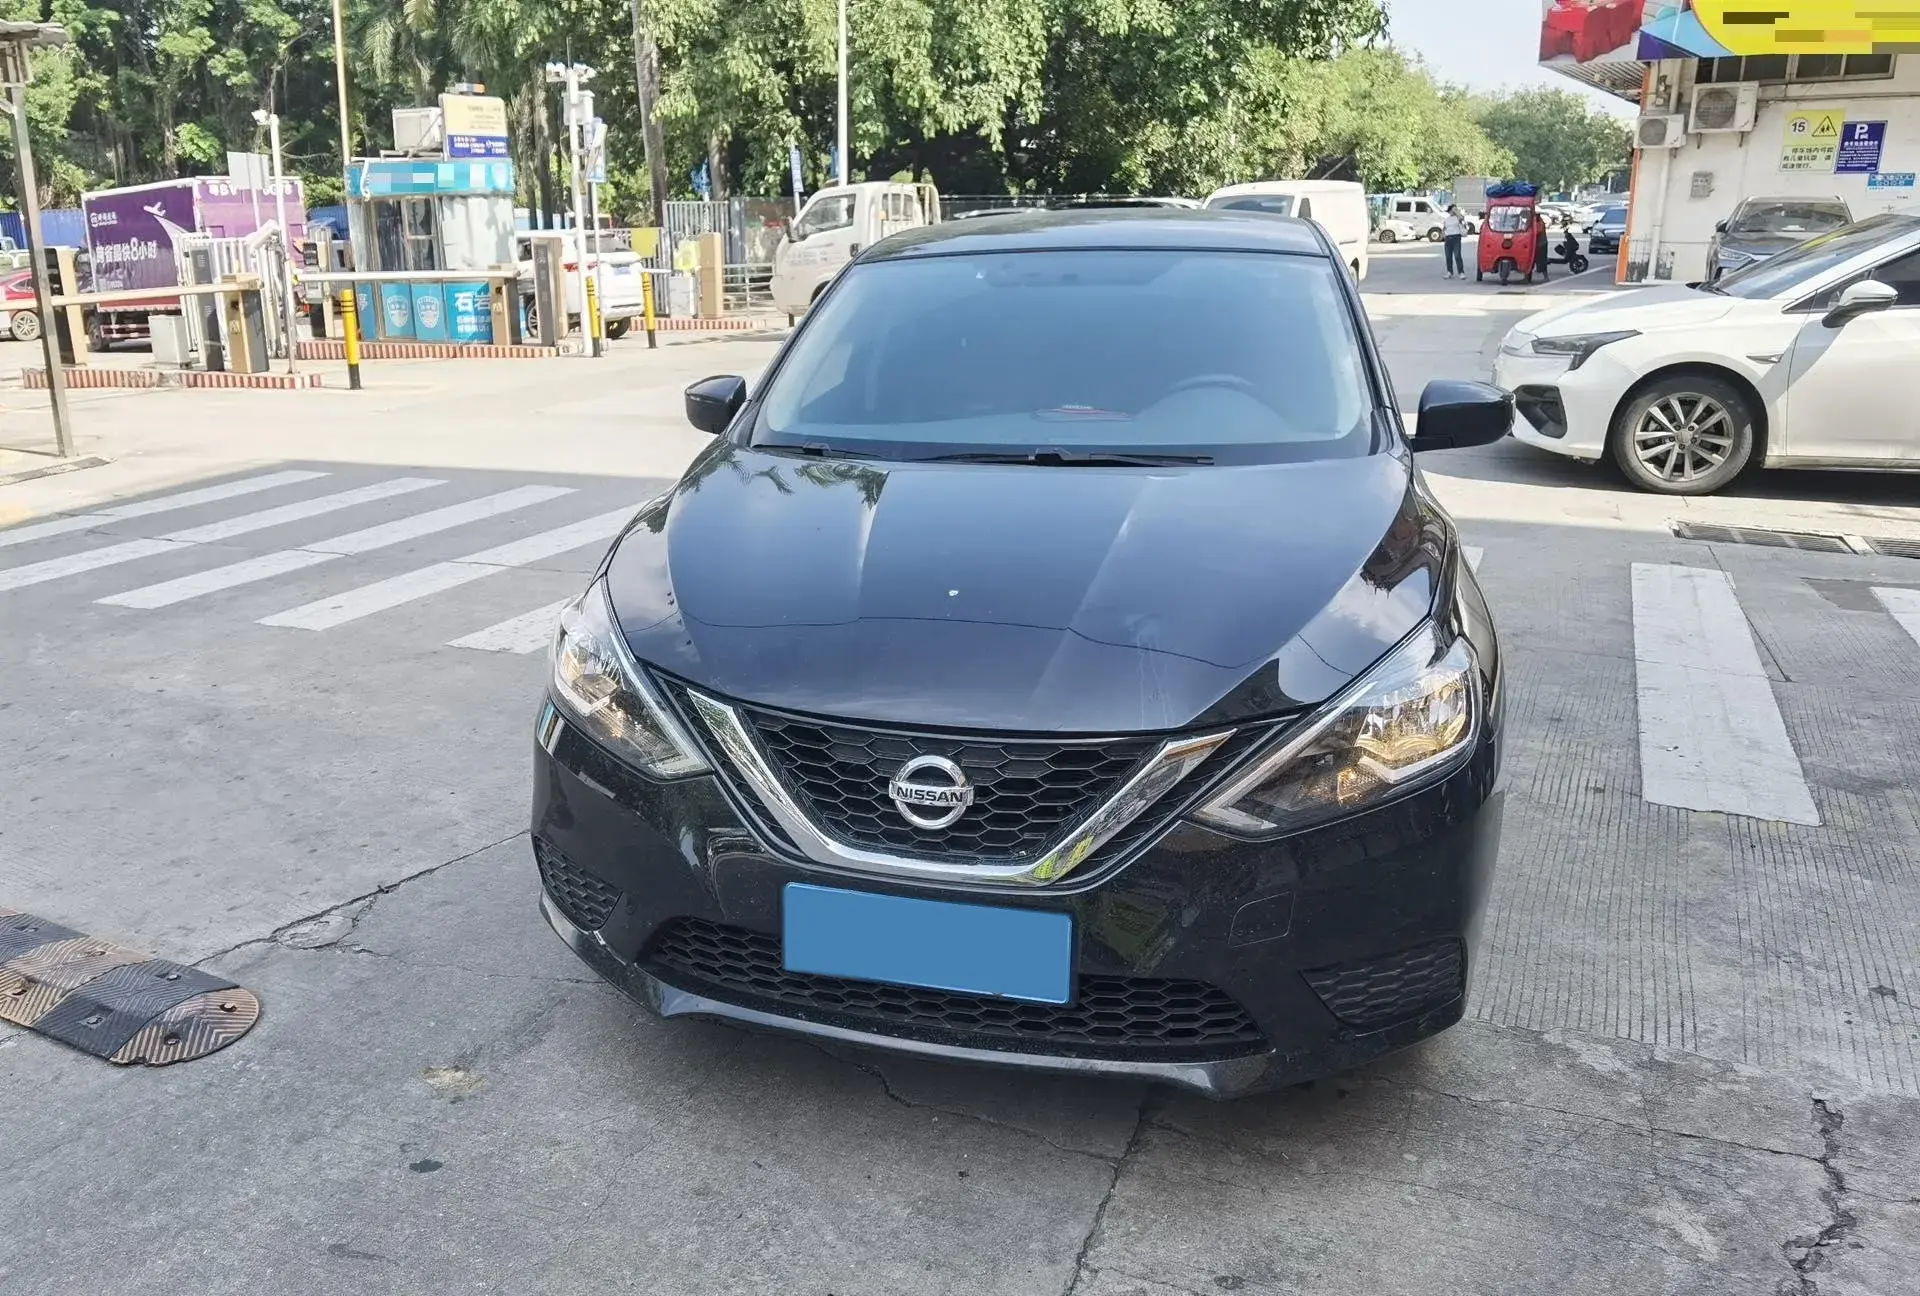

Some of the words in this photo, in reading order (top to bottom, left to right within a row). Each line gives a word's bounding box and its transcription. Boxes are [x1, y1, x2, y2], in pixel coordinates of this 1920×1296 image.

[1791, 121, 1806, 133] 15
[1854, 123, 1869, 140] P
[896, 786, 963, 803] NISSAN
